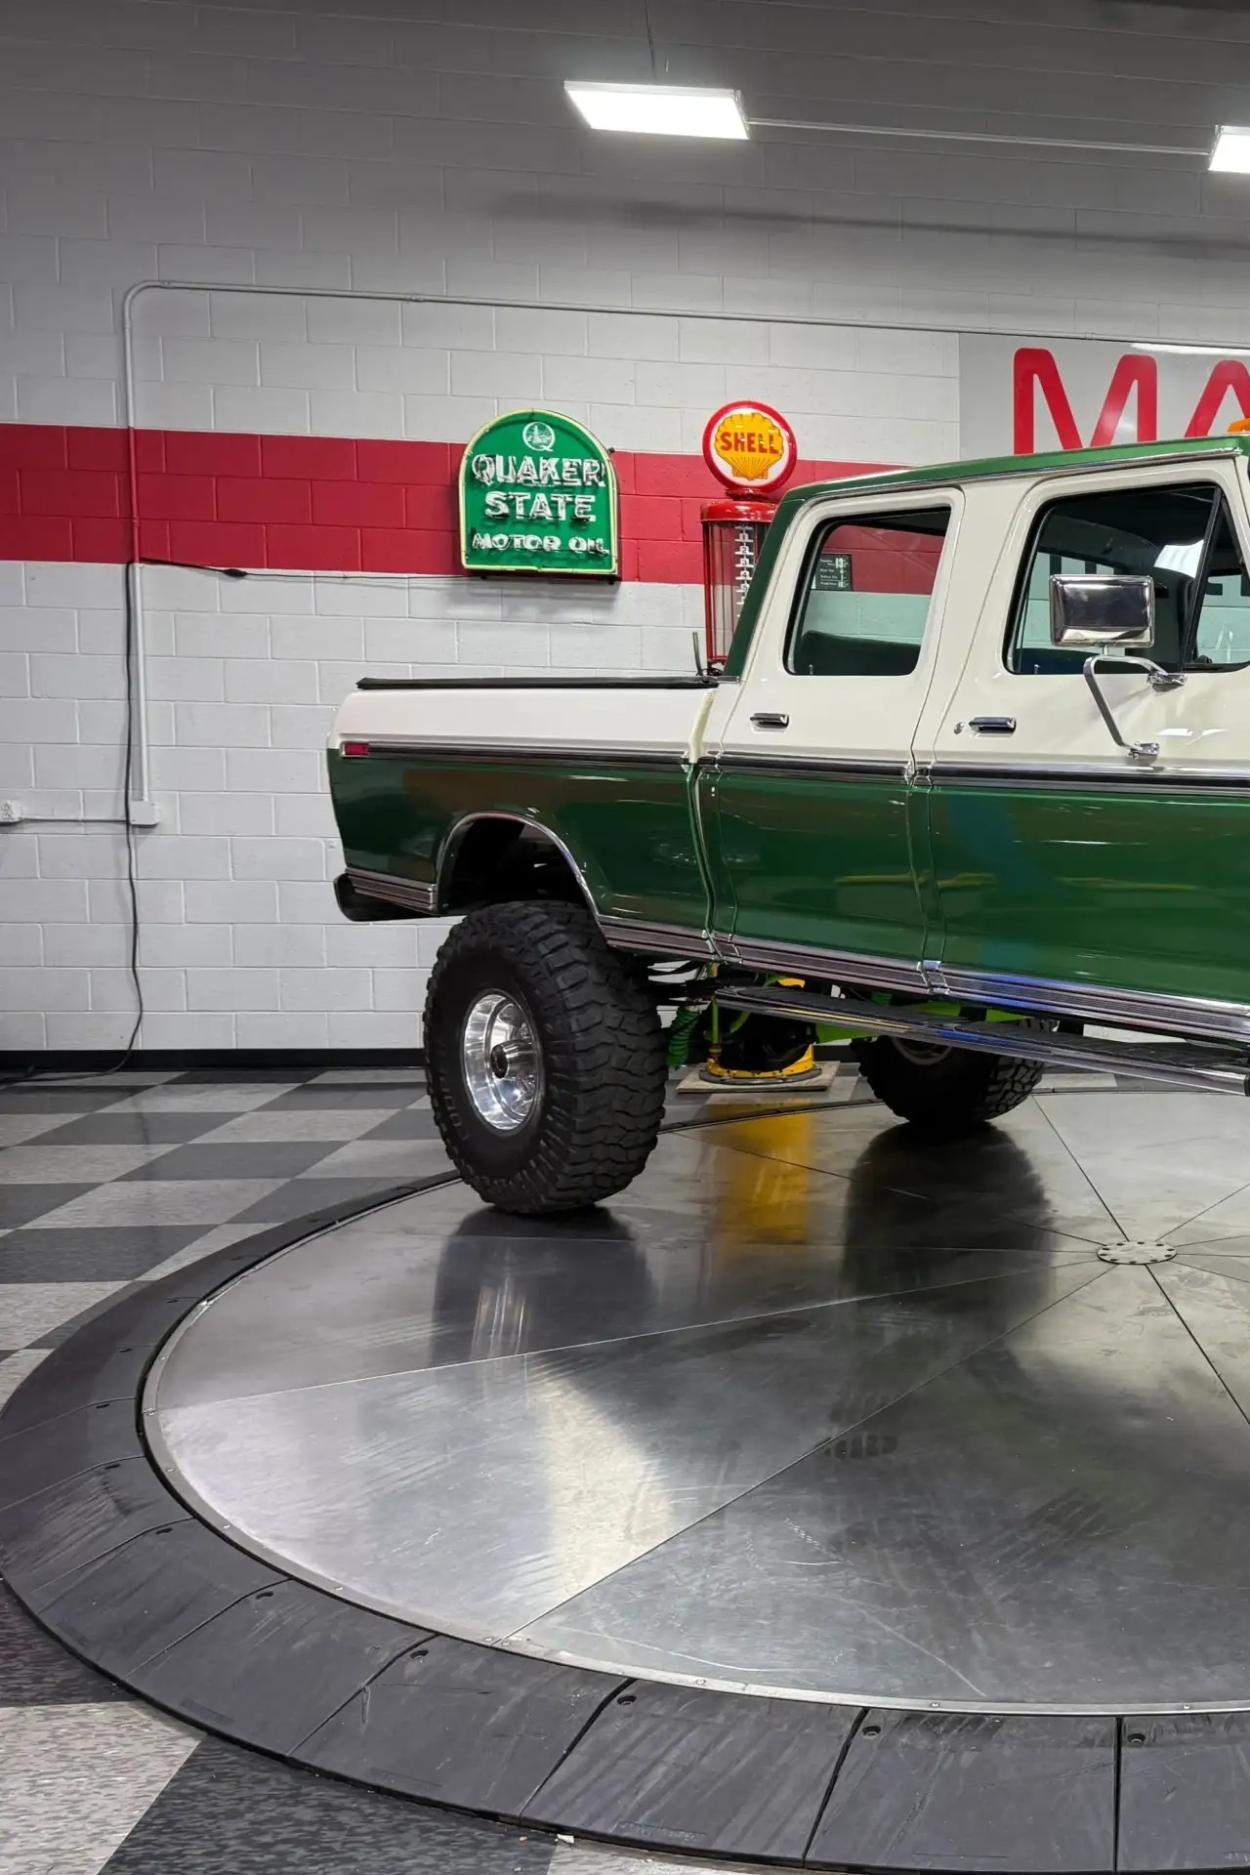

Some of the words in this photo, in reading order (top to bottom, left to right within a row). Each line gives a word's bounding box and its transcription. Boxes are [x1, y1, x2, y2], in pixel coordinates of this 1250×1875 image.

[719, 431, 779, 455] SHELL
[471, 453, 606, 488] QUAKER
[484, 490, 596, 523] STATE
[472, 531, 561, 552] MOTOR
[568, 534, 610, 555] OIL
